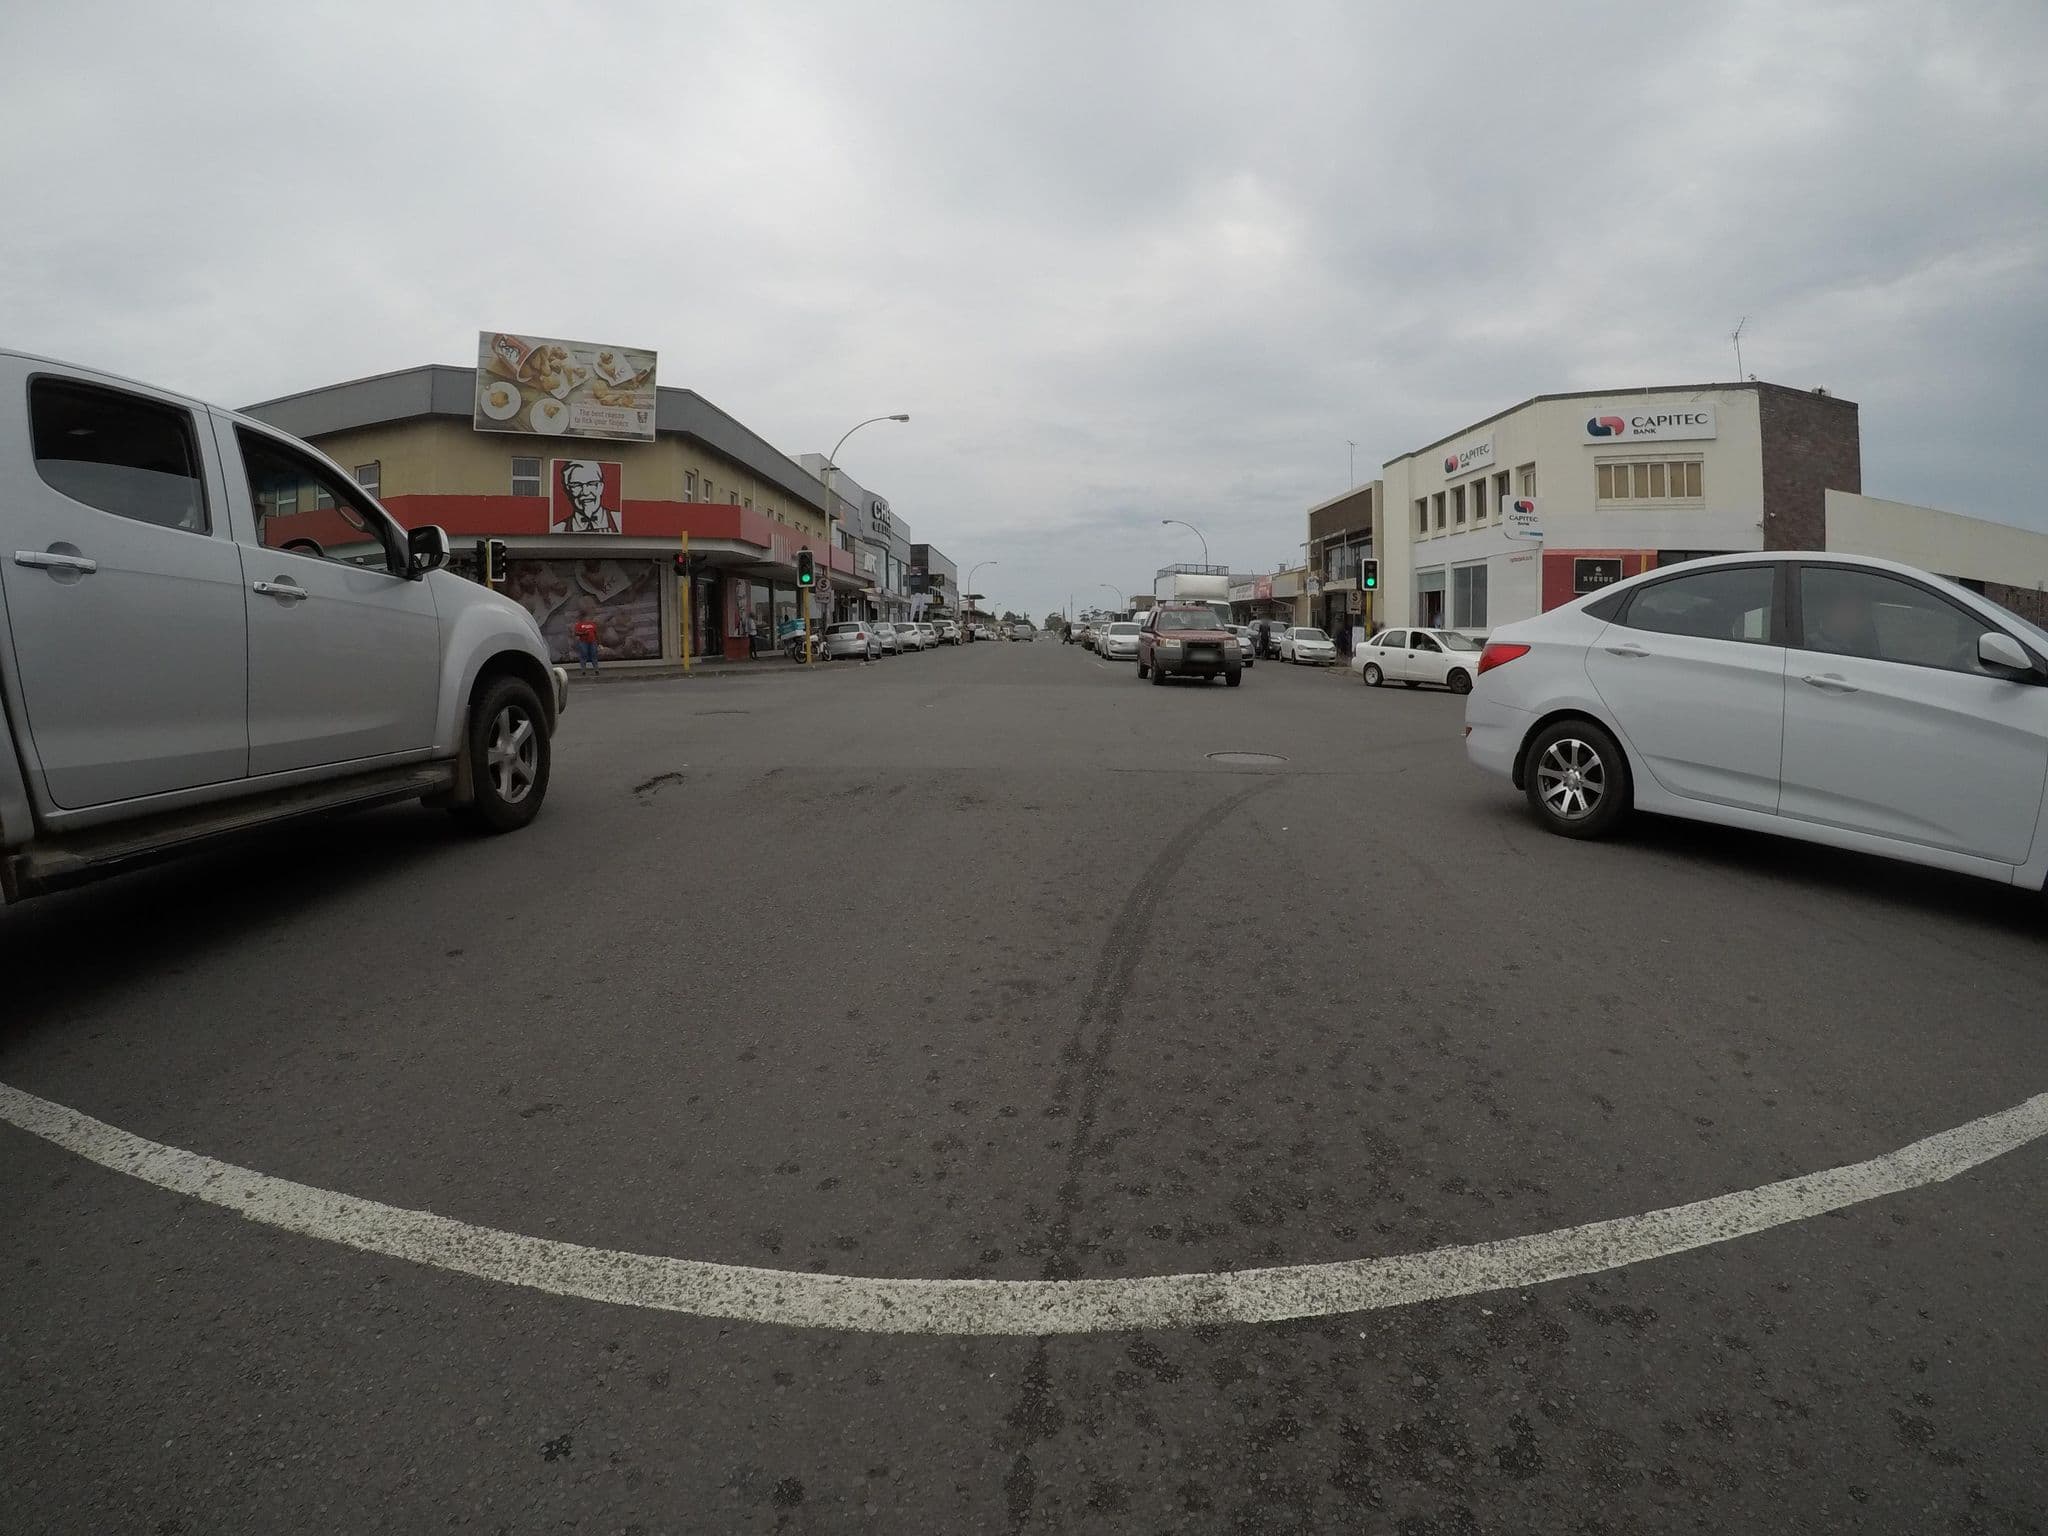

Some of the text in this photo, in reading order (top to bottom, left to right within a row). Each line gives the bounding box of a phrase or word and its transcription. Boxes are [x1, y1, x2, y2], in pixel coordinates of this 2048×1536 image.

[1631, 413, 1708, 428] CAPITEC
[1460, 443, 1490, 463] CAPITEC
[1509, 514, 1539, 522] CAPITEC
